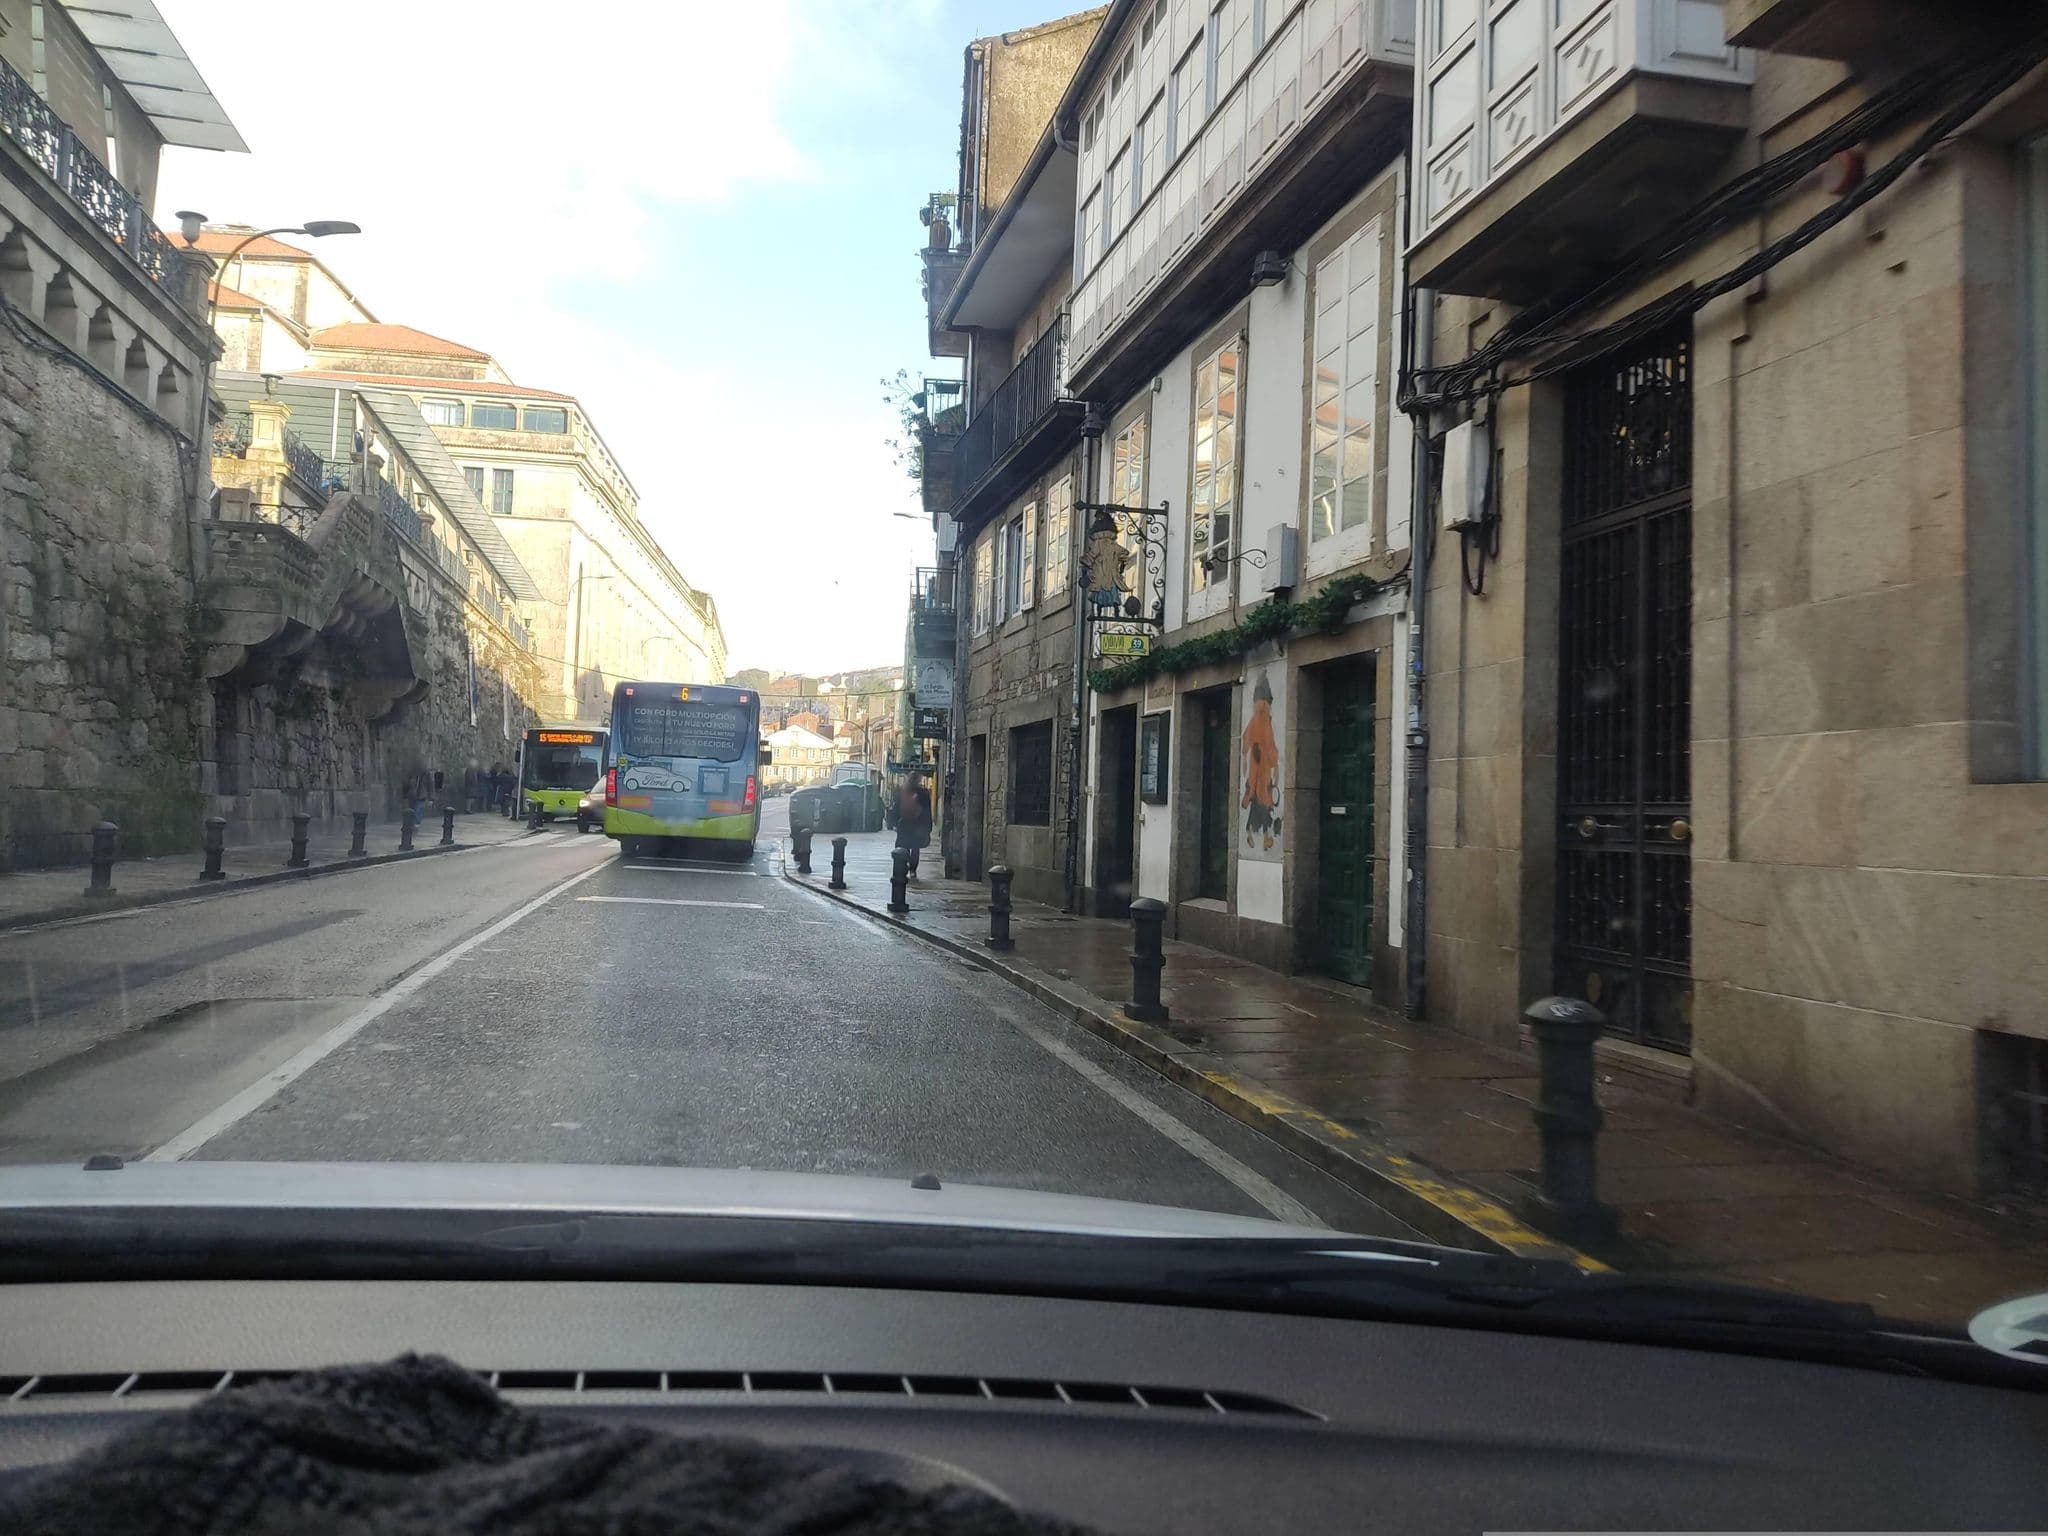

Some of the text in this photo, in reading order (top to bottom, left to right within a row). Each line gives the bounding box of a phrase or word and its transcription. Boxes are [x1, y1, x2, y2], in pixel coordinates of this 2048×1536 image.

[681, 687, 689, 701] 6
[654, 708, 677, 717] FORD
[679, 710, 736, 721] MULTIOPCIÓN
[672, 719, 683, 727] TU
[685, 720, 712, 728] NUEVO
[642, 775, 669, 786] Ford
